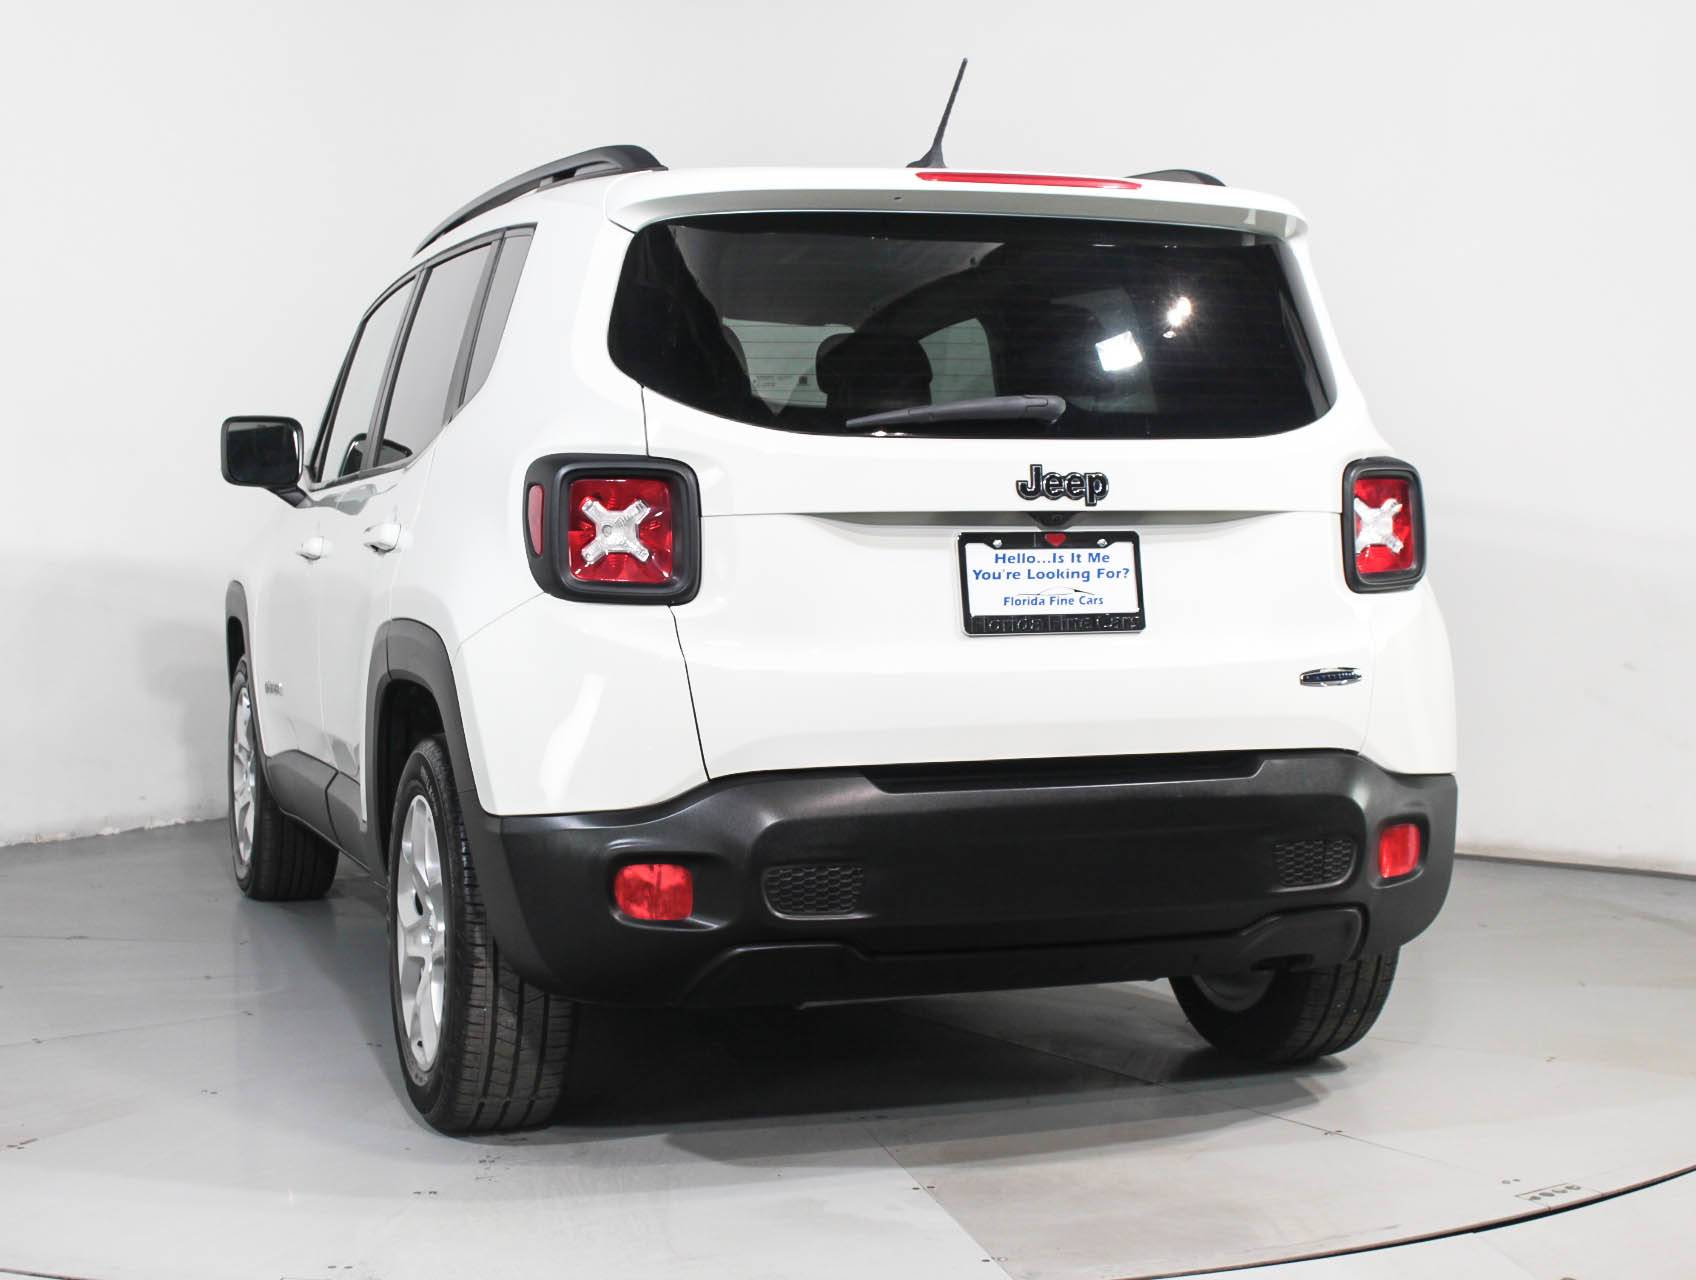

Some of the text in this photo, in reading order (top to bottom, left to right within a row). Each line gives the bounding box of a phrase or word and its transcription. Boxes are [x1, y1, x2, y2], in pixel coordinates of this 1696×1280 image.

[1016, 464, 1109, 506] Jeep
[1071, 552, 1082, 563] It
[1088, 552, 1110, 563] Me
[972, 568, 1130, 582] You're Looking For?
[1003, 595, 1104, 606] Florida Fine Cars
